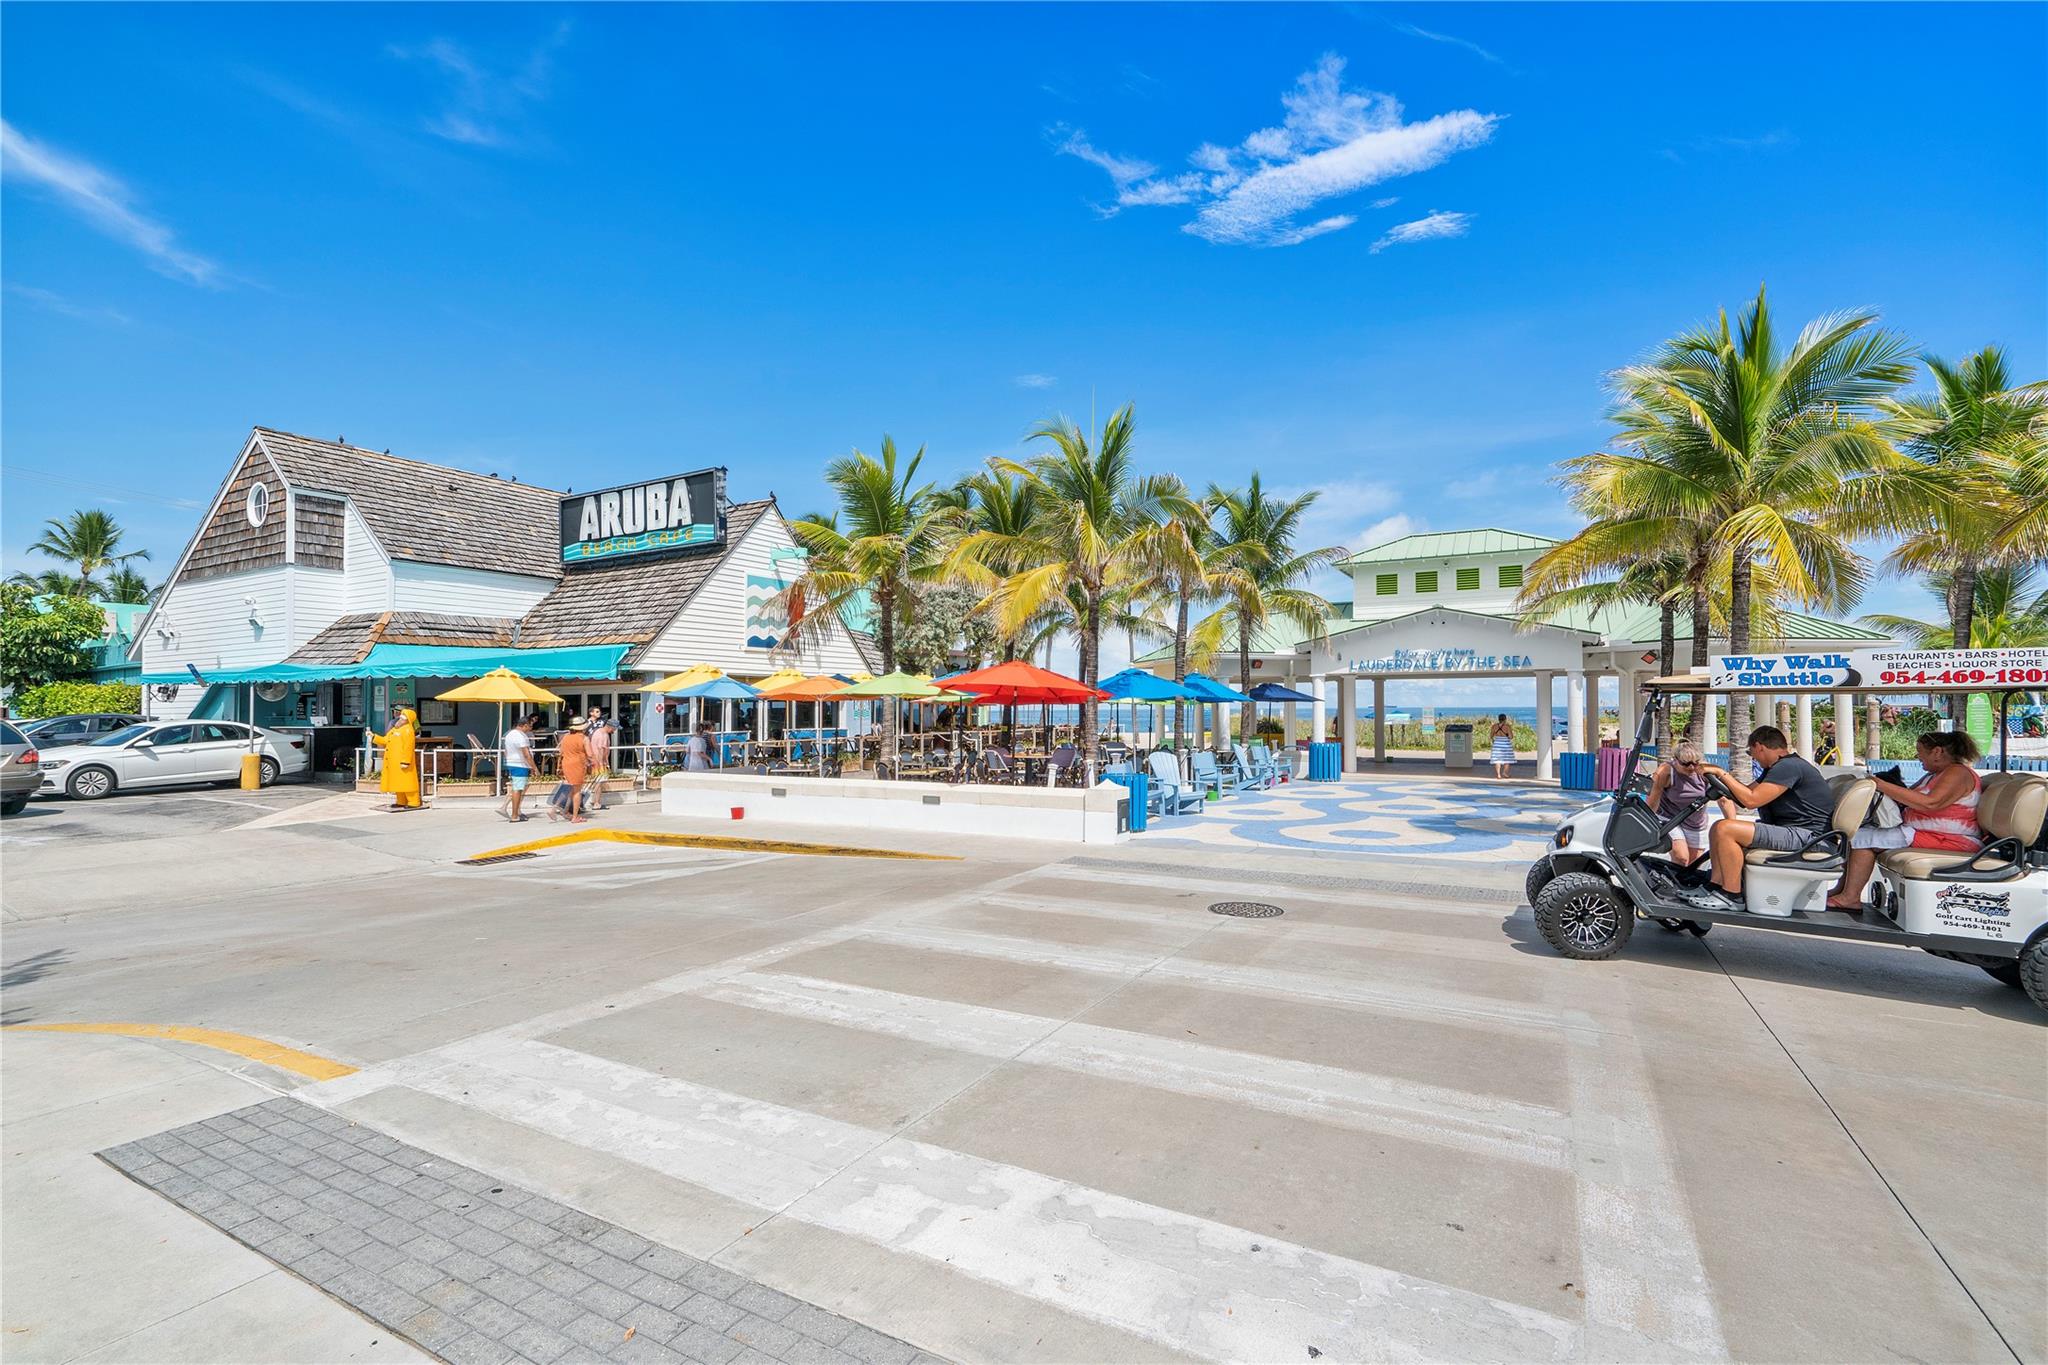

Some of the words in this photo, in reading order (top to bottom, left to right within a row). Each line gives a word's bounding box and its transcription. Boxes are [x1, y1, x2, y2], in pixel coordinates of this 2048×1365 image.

[579, 478, 693, 541] ARUBA
[582, 538, 637, 556] BEACH
[647, 528, 694, 545] CAFE
[1454, 648, 1475, 656] here
[1872, 652, 1955, 661] RESTAURANTS
[1965, 651, 1998, 659] BARS
[2008, 650, 2048, 658] HOTEL
[1350, 657, 1439, 671] LAUDERDALE
[1445, 657, 1461, 669] BY
[1469, 656, 1496, 668] THE
[1503, 655, 1532, 667] SEA
[1721, 656, 1777, 674] Why
[1783, 653, 1851, 670] Walk
[1887, 661, 1942, 669] BEACHES
[1952, 660, 1998, 669] LIQUOR
[2001, 659, 2042, 667] STORE
[1737, 671, 1834, 687] Shuttle
[1943, 920, 2002, 932] 954-469-1801
[1954, 914, 1973, 922] Cart
[1974, 917, 2011, 927] Lighting
